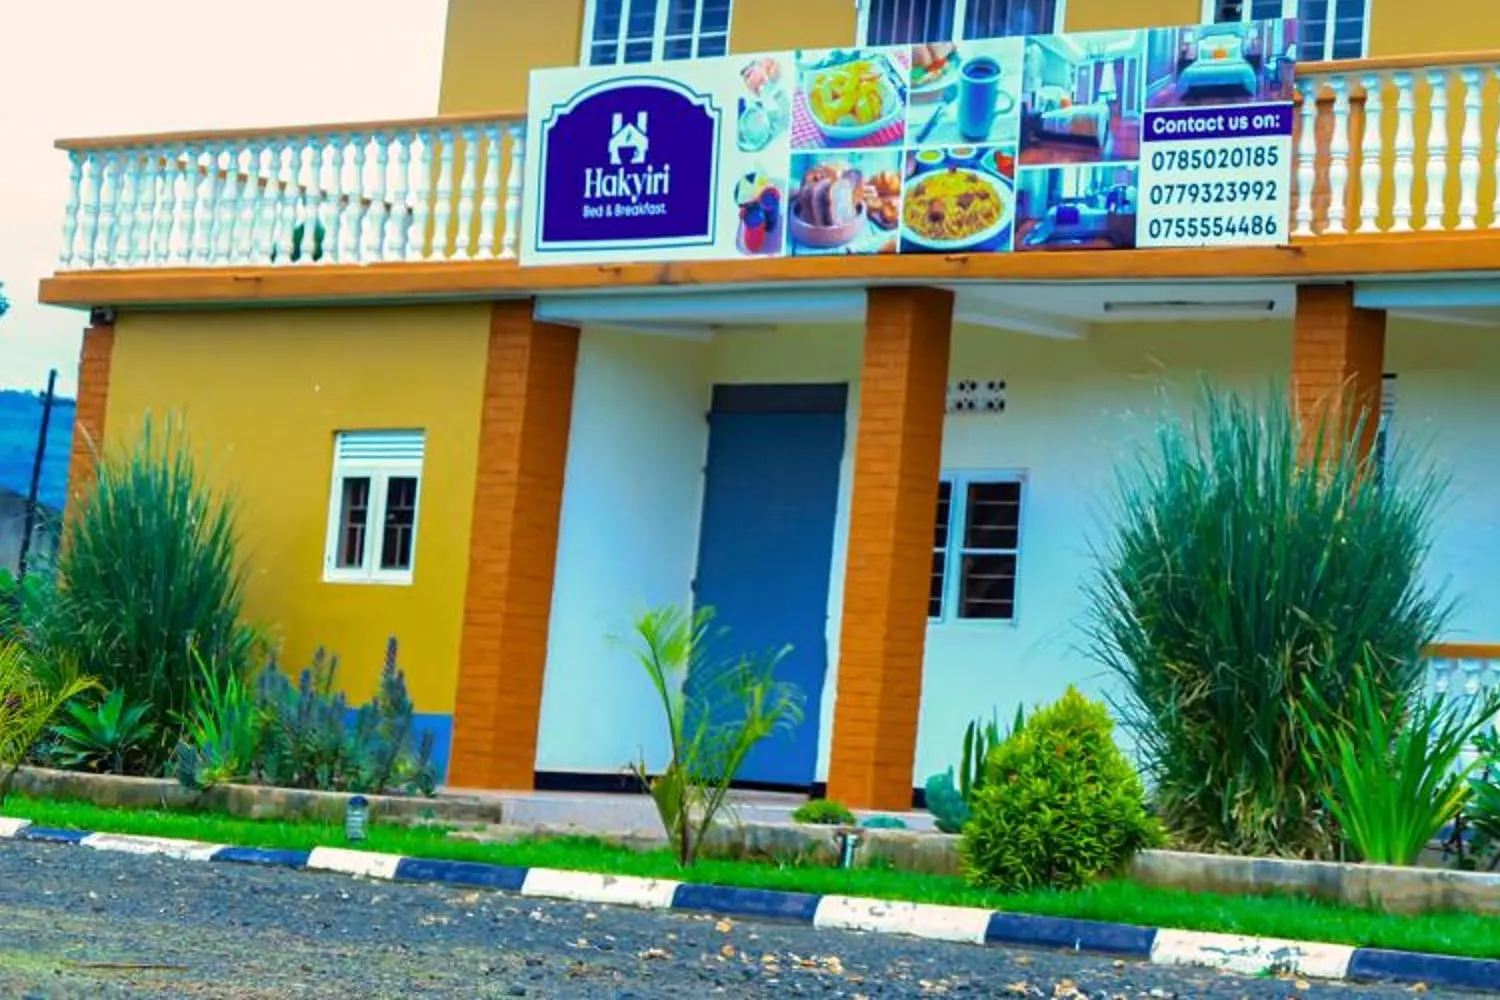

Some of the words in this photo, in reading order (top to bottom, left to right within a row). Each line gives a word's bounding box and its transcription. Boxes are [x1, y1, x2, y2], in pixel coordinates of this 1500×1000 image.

[1153, 116, 1224, 133] Contact
[1228, 115, 1248, 129] us
[1252, 114, 1281, 129] on:
[1152, 146, 1279, 171] 0785020185
[584, 163, 669, 203] Hakyiri
[1150, 181, 1277, 205] 0779323992
[583, 204, 603, 218] Bed
[606, 204, 612, 217] &
[1149, 216, 1277, 239] 0755554486
